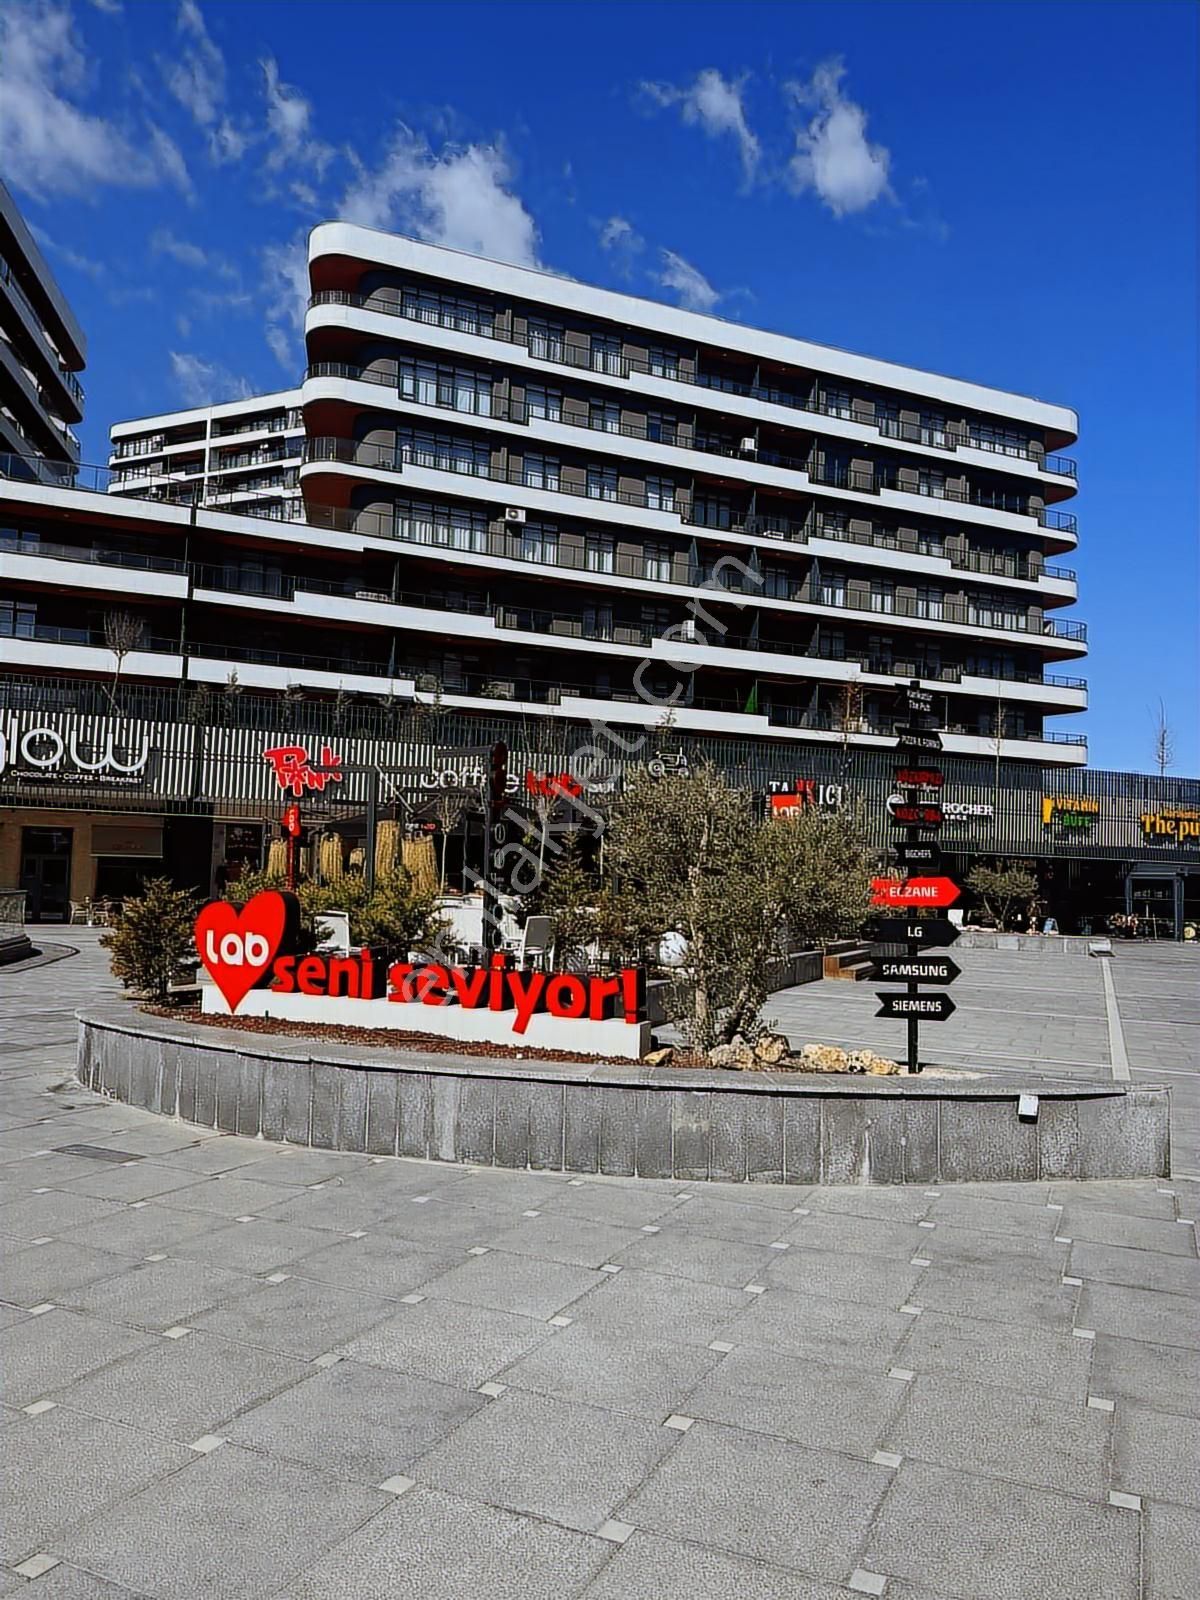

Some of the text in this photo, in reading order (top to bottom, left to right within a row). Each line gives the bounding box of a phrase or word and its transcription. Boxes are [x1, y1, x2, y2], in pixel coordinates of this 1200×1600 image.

[0, 717, 149, 777] low
[420, 764, 520, 794] coffe
[942, 802, 994, 816] ROCHER
[1055, 798, 1100, 813] VITAMIN
[1140, 812, 1176, 834] The
[907, 926, 923, 938] LG
[882, 964, 948, 977] SAMSUNG
[271, 947, 637, 1034] seni seviyor!
[892, 1000, 942, 1012] SIEMENS
